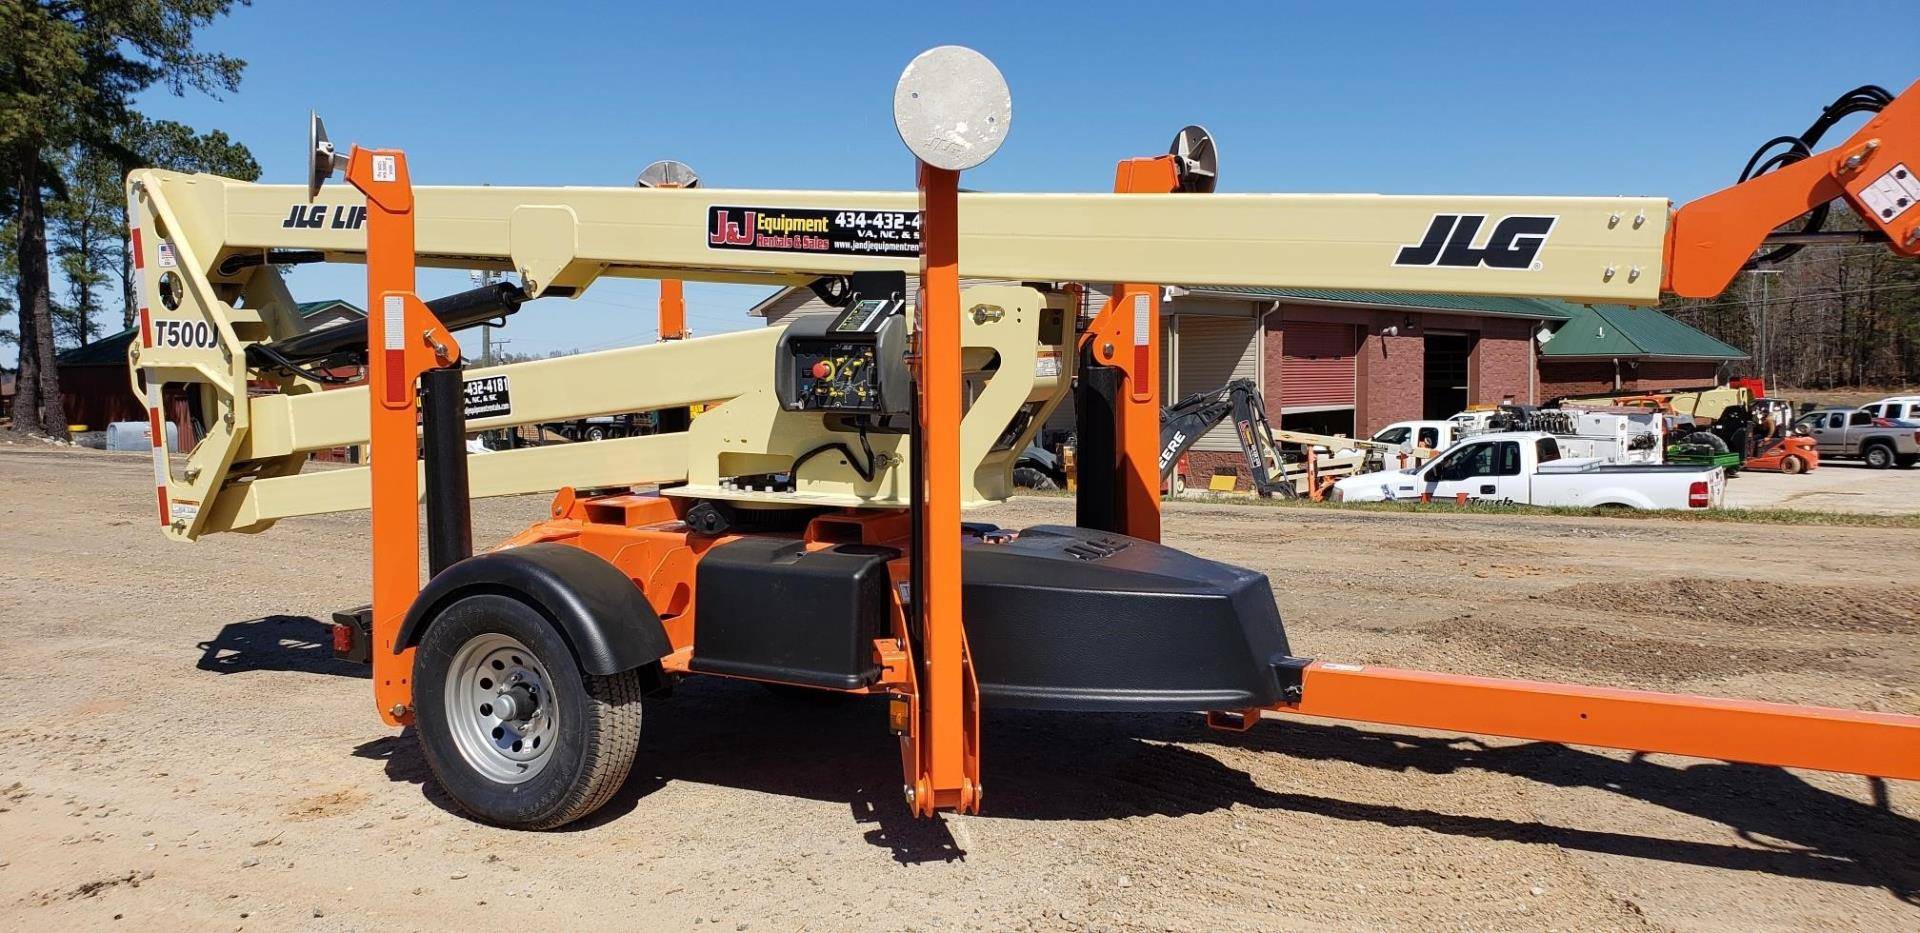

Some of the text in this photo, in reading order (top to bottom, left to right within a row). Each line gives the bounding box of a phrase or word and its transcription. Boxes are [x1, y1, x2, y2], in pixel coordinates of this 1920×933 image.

[282, 205, 328, 229] JLG
[710, 210, 756, 246] J&J
[757, 213, 829, 235] Equipment
[756, 233, 830, 250] Rentals & Sales
[857, 229, 878, 239] VA,
[880, 230, 899, 240] NC,
[901, 231, 912, 239] &
[1394, 214, 1557, 270] JLG
[155, 320, 219, 349] T500J
